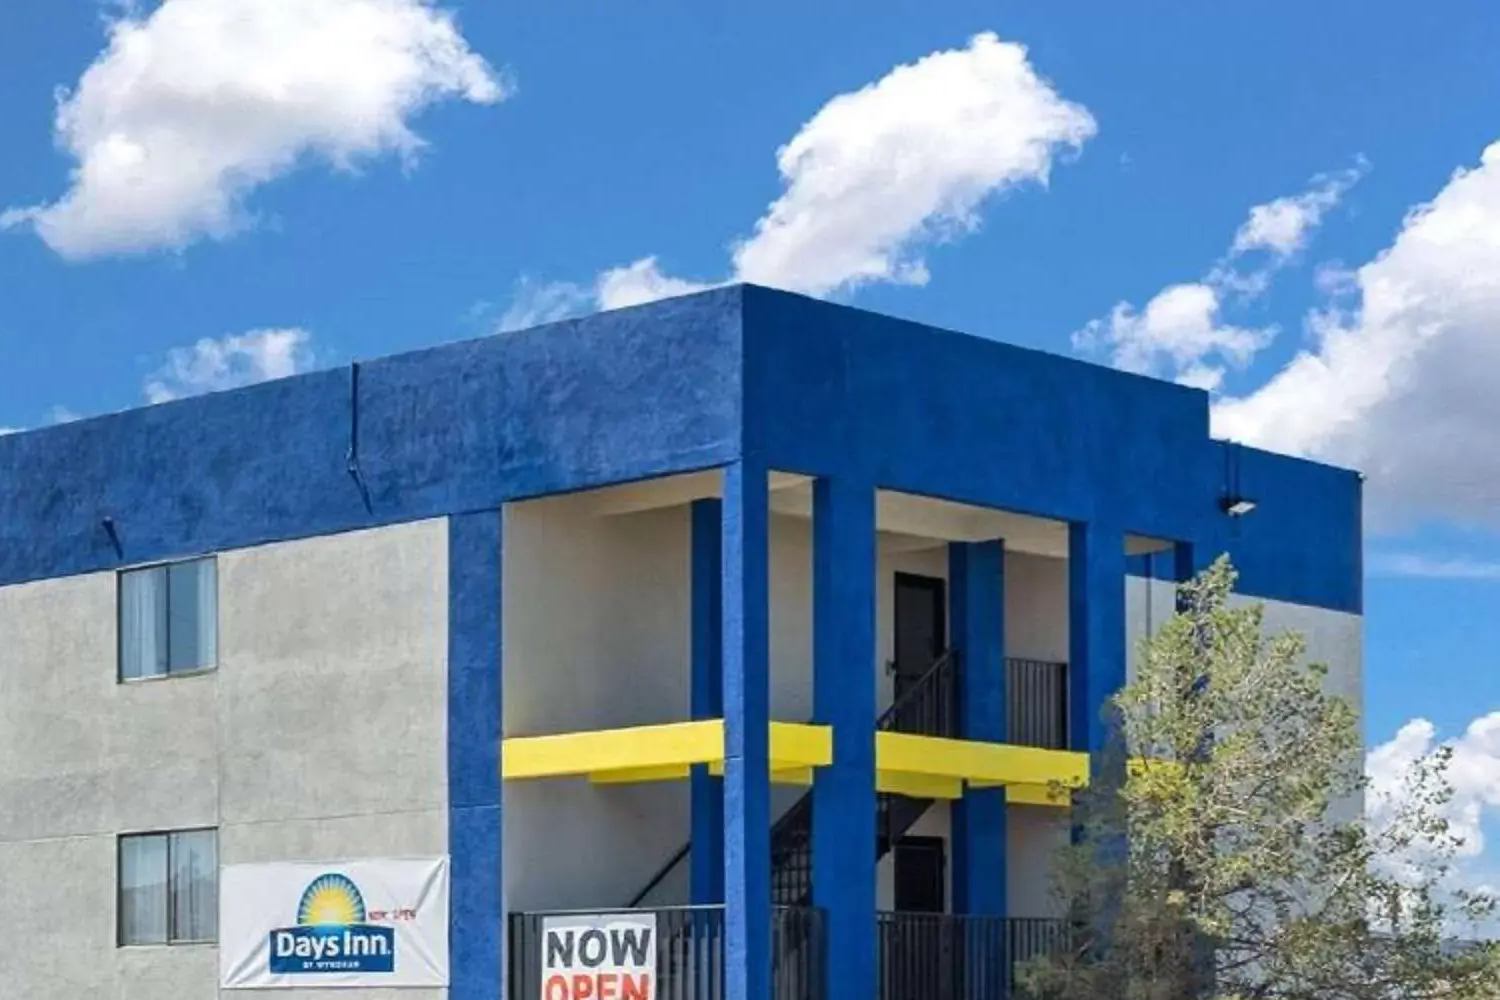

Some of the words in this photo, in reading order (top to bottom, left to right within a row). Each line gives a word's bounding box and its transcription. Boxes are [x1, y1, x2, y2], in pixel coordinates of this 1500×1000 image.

[276, 931, 340, 960] Days
[343, 931, 386, 956] Inn
[547, 927, 652, 968] NOW
